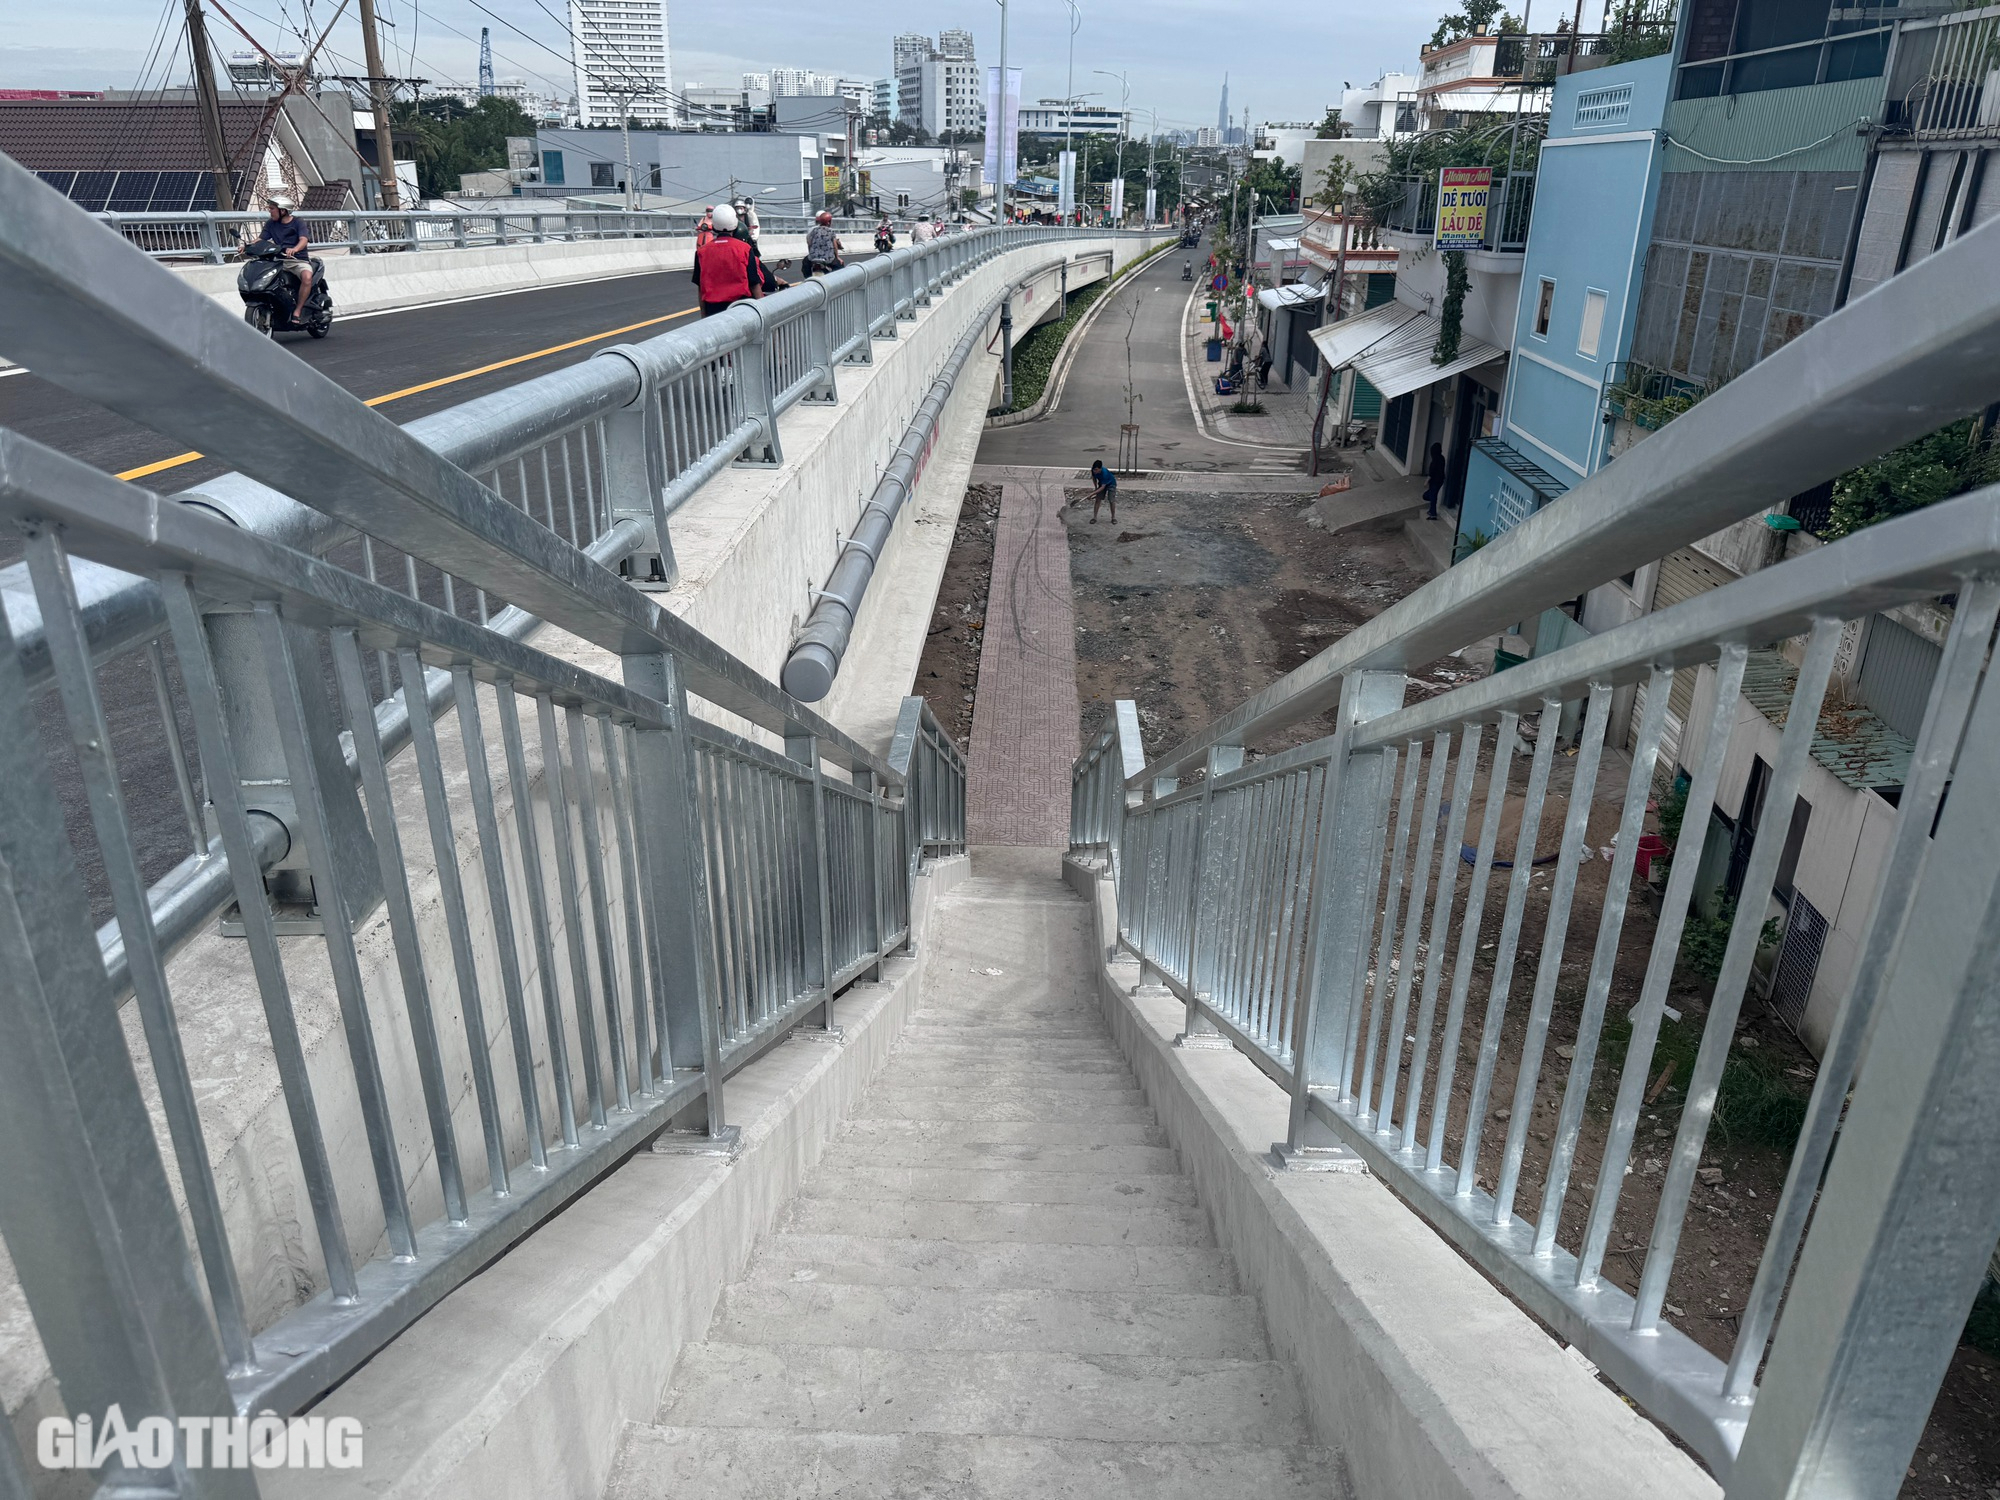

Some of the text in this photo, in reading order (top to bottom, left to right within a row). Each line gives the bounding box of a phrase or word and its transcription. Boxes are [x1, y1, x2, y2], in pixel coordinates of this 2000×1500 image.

[1442, 188, 1488, 207] DÊ TƯƠI
[1441, 208, 1483, 231] LẨU DÊ
